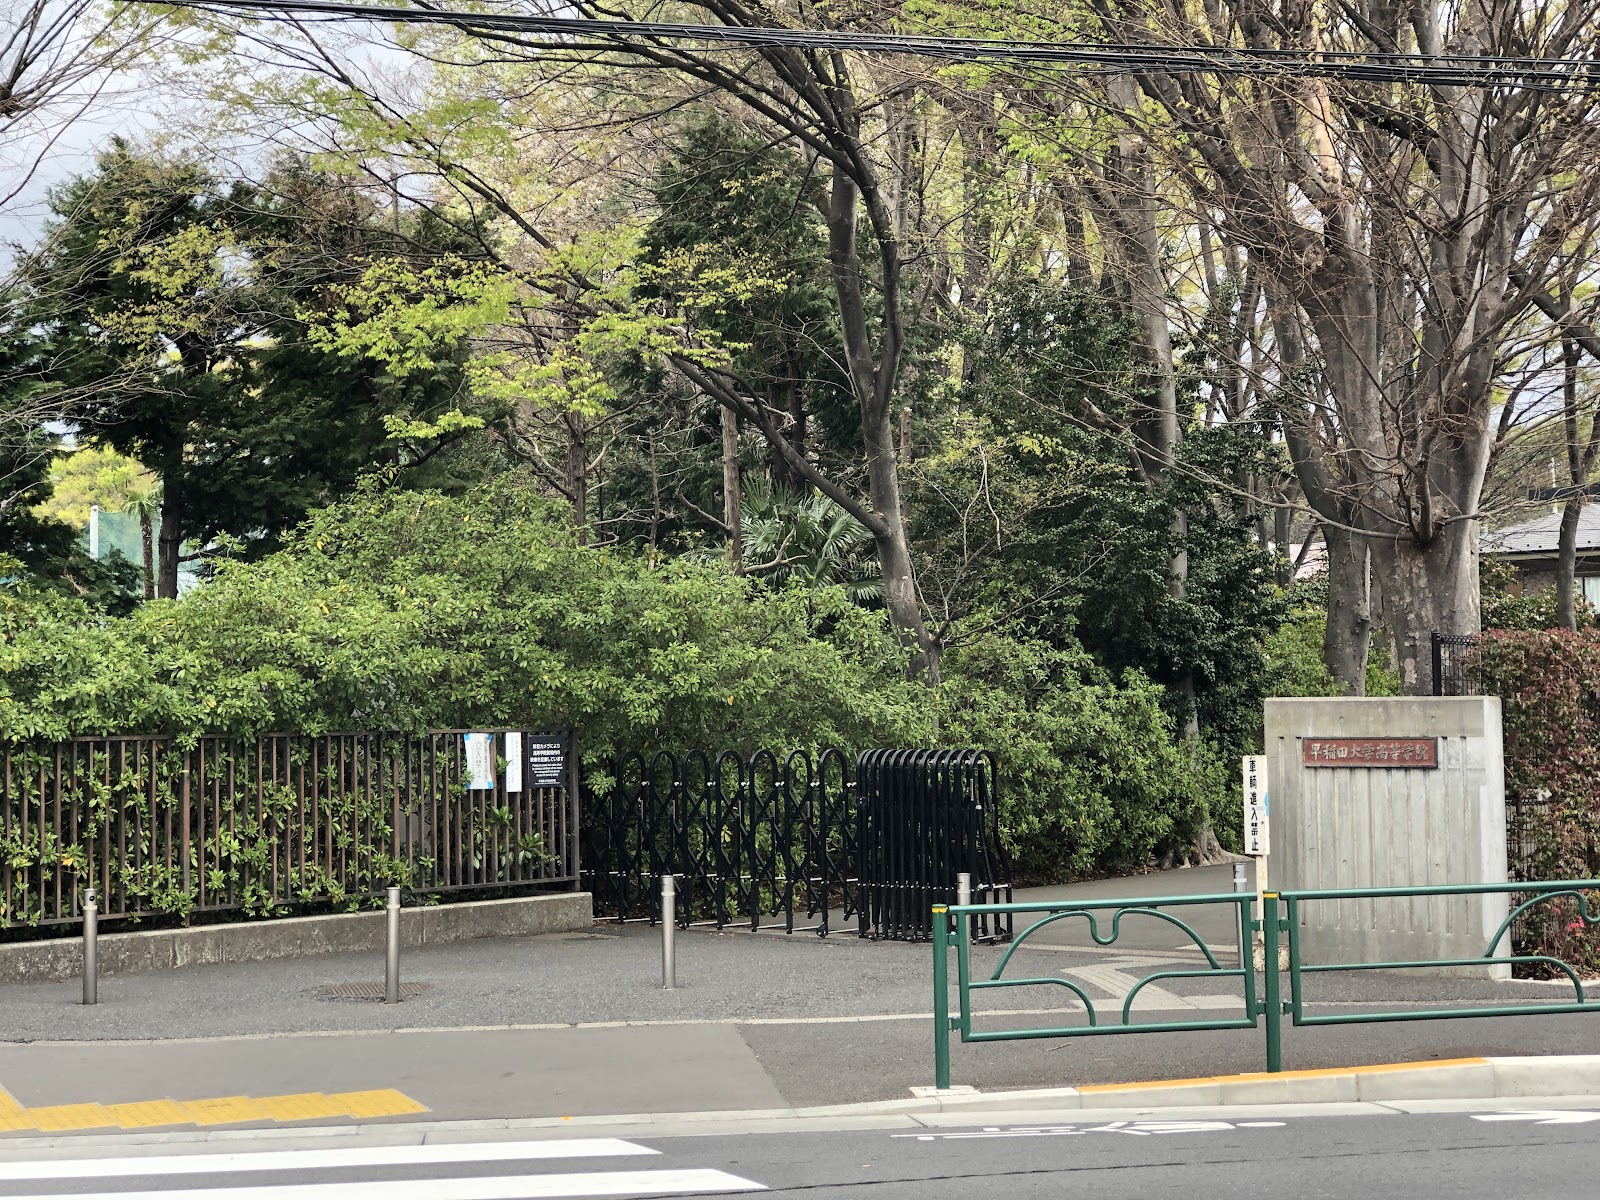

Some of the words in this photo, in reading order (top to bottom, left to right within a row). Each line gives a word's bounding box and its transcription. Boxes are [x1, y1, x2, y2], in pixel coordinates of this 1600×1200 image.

[1310, 743, 1429, 761] 早稲田大学高等学院
